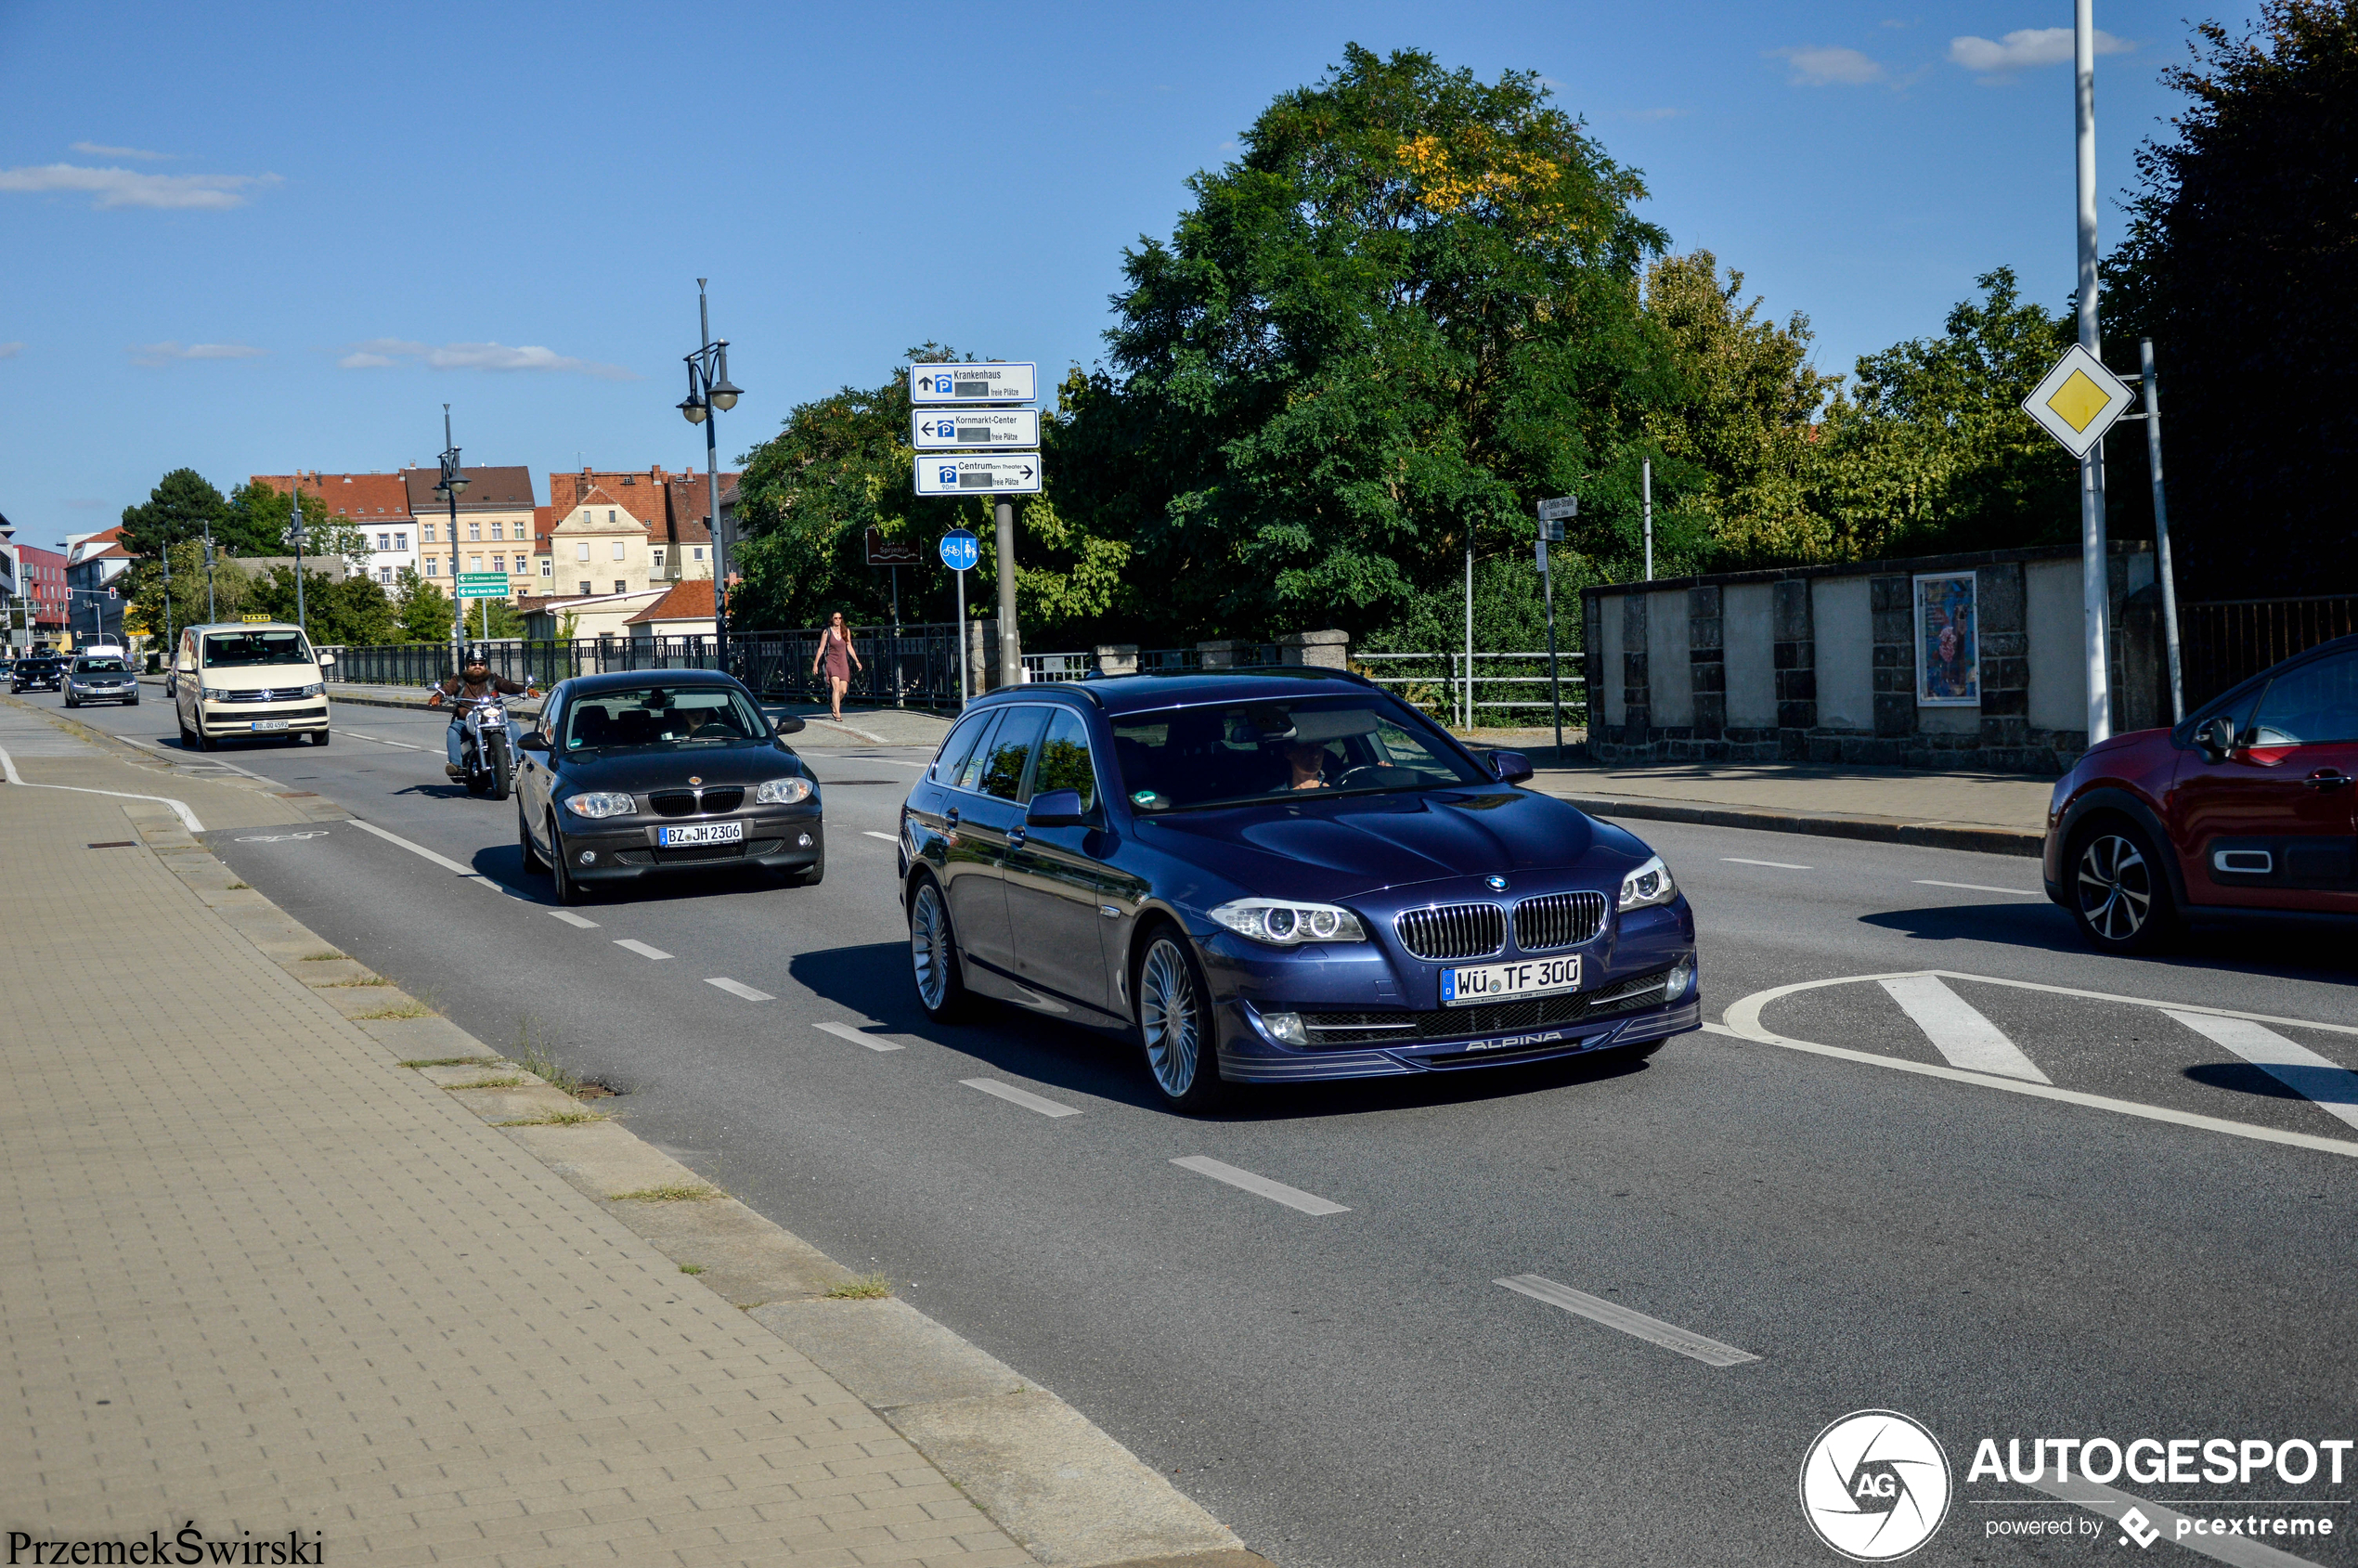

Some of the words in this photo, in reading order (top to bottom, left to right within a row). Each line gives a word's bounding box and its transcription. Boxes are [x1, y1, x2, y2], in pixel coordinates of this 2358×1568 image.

[953, 369, 1001, 380] Krankenhaus
[991, 388, 1003, 396] freie
[955, 415, 1017, 424] Kornmarkt-Center
[991, 433, 1003, 441] freie
[958, 461, 992, 471] Centrum
[992, 478, 1004, 486] freie
[1004, 477, 1019, 486] Plätze
[668, 829, 684, 842] BZ
[693, 827, 708, 841] JH
[710, 824, 740, 839] 2306
[1458, 970, 1487, 994] WÜ
[1503, 965, 1533, 990] TF
[1537, 959, 1578, 986] 300
[1445, 987, 1452, 995] D
[1465, 1031, 1563, 1051] ALPINA
